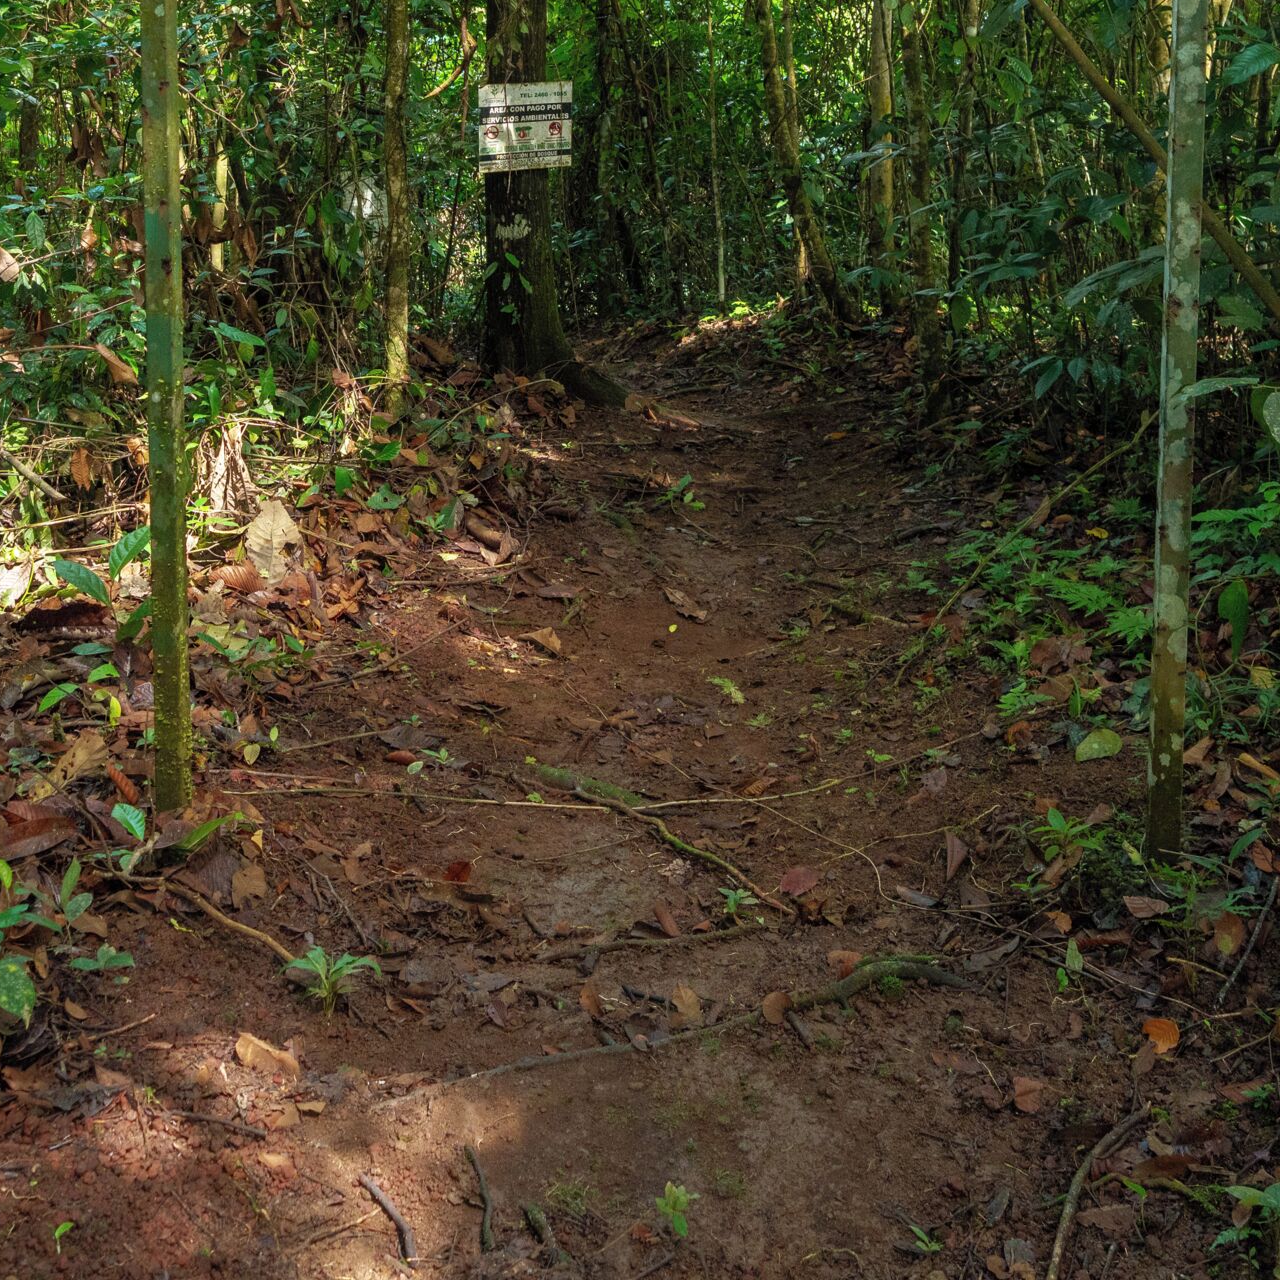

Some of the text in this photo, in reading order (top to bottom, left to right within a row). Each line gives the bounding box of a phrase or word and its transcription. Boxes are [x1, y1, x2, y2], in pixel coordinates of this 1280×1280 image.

[489, 103, 562, 114] AREA CON PAGO POR
[482, 112, 569, 124] SERVICIOS AMBIENTALES
